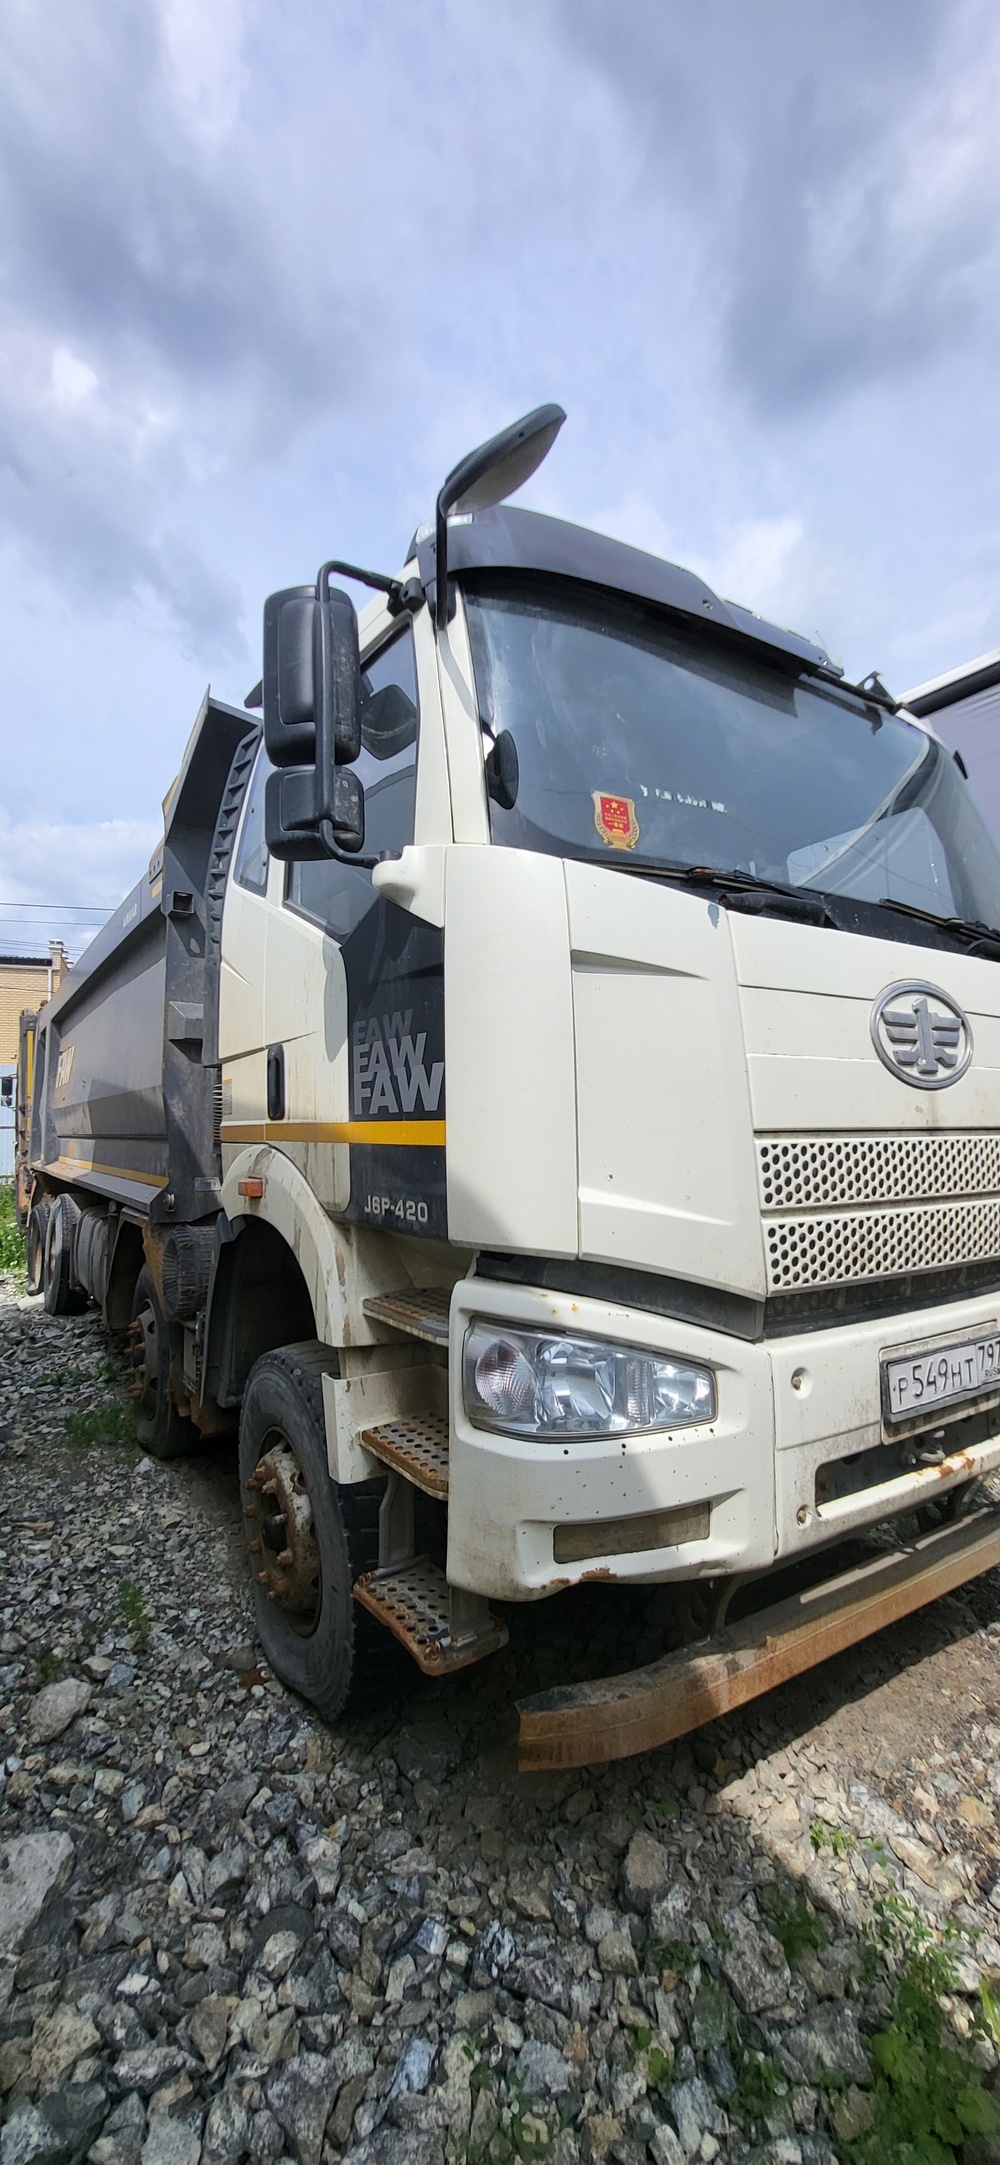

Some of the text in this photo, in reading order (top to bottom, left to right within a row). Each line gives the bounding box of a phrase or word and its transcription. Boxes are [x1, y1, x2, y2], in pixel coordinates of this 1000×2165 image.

[353, 1008, 414, 1046] FAW
[353, 1032, 427, 1076] FAW
[353, 1062, 445, 1115] FAW
[364, 1194, 428, 1223] J6P-420
[984, 1367, 998, 1378] RUS
